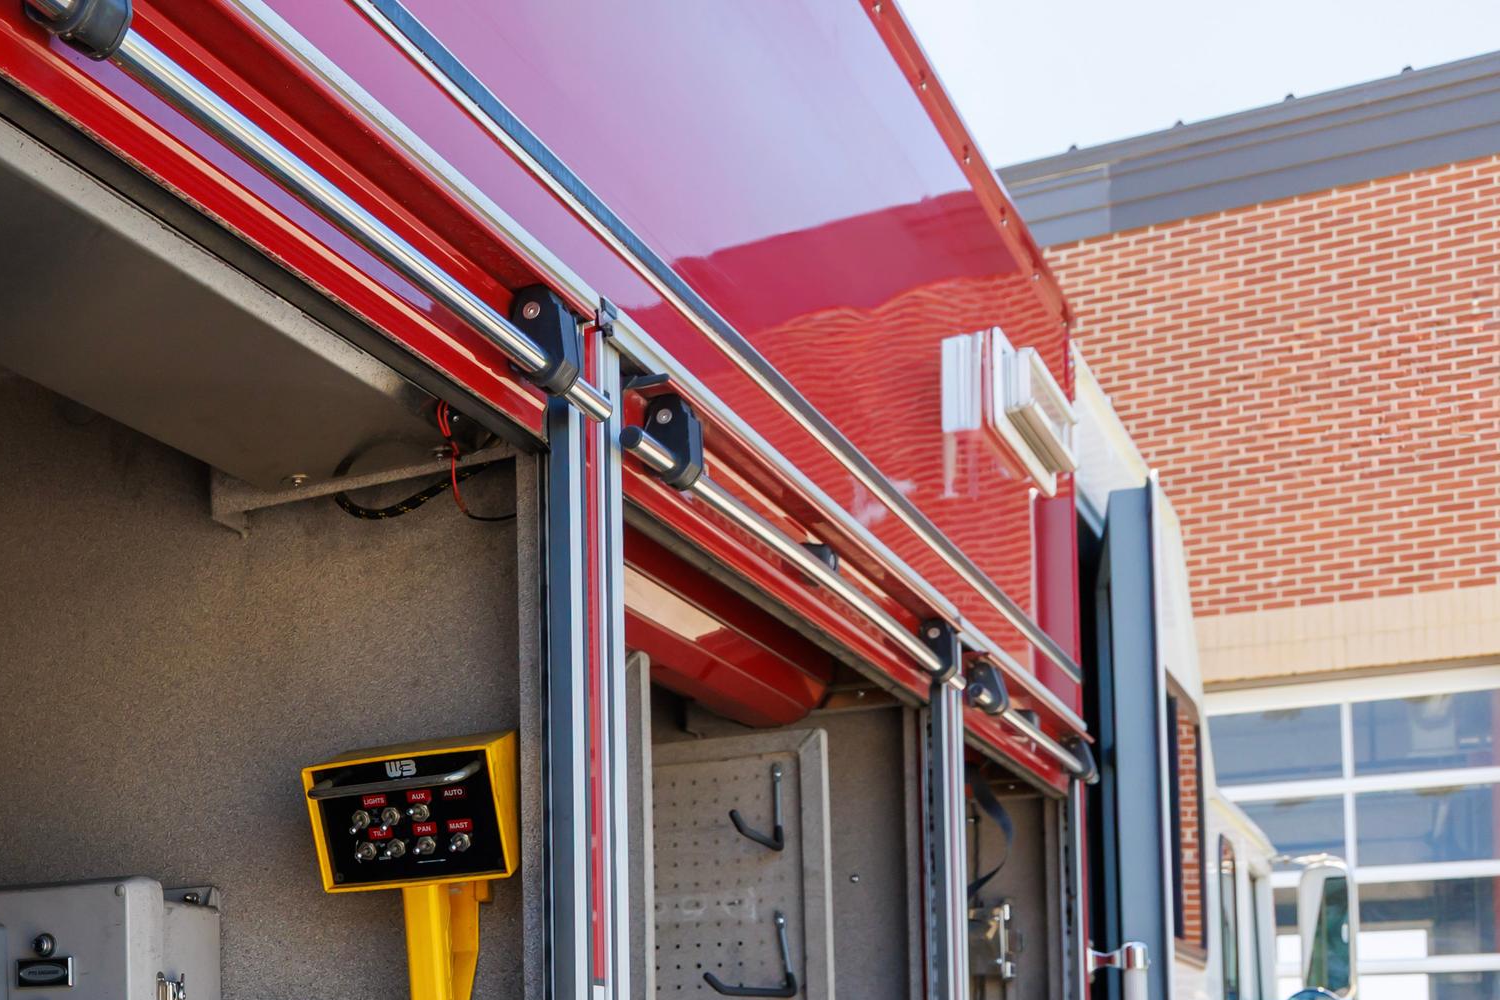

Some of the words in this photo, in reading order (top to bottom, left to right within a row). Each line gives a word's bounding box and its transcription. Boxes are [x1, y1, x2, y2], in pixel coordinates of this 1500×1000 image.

[444, 788, 463, 797] AUTO
[364, 797, 385, 805] LIGHTS
[449, 821, 468, 829] MAST
